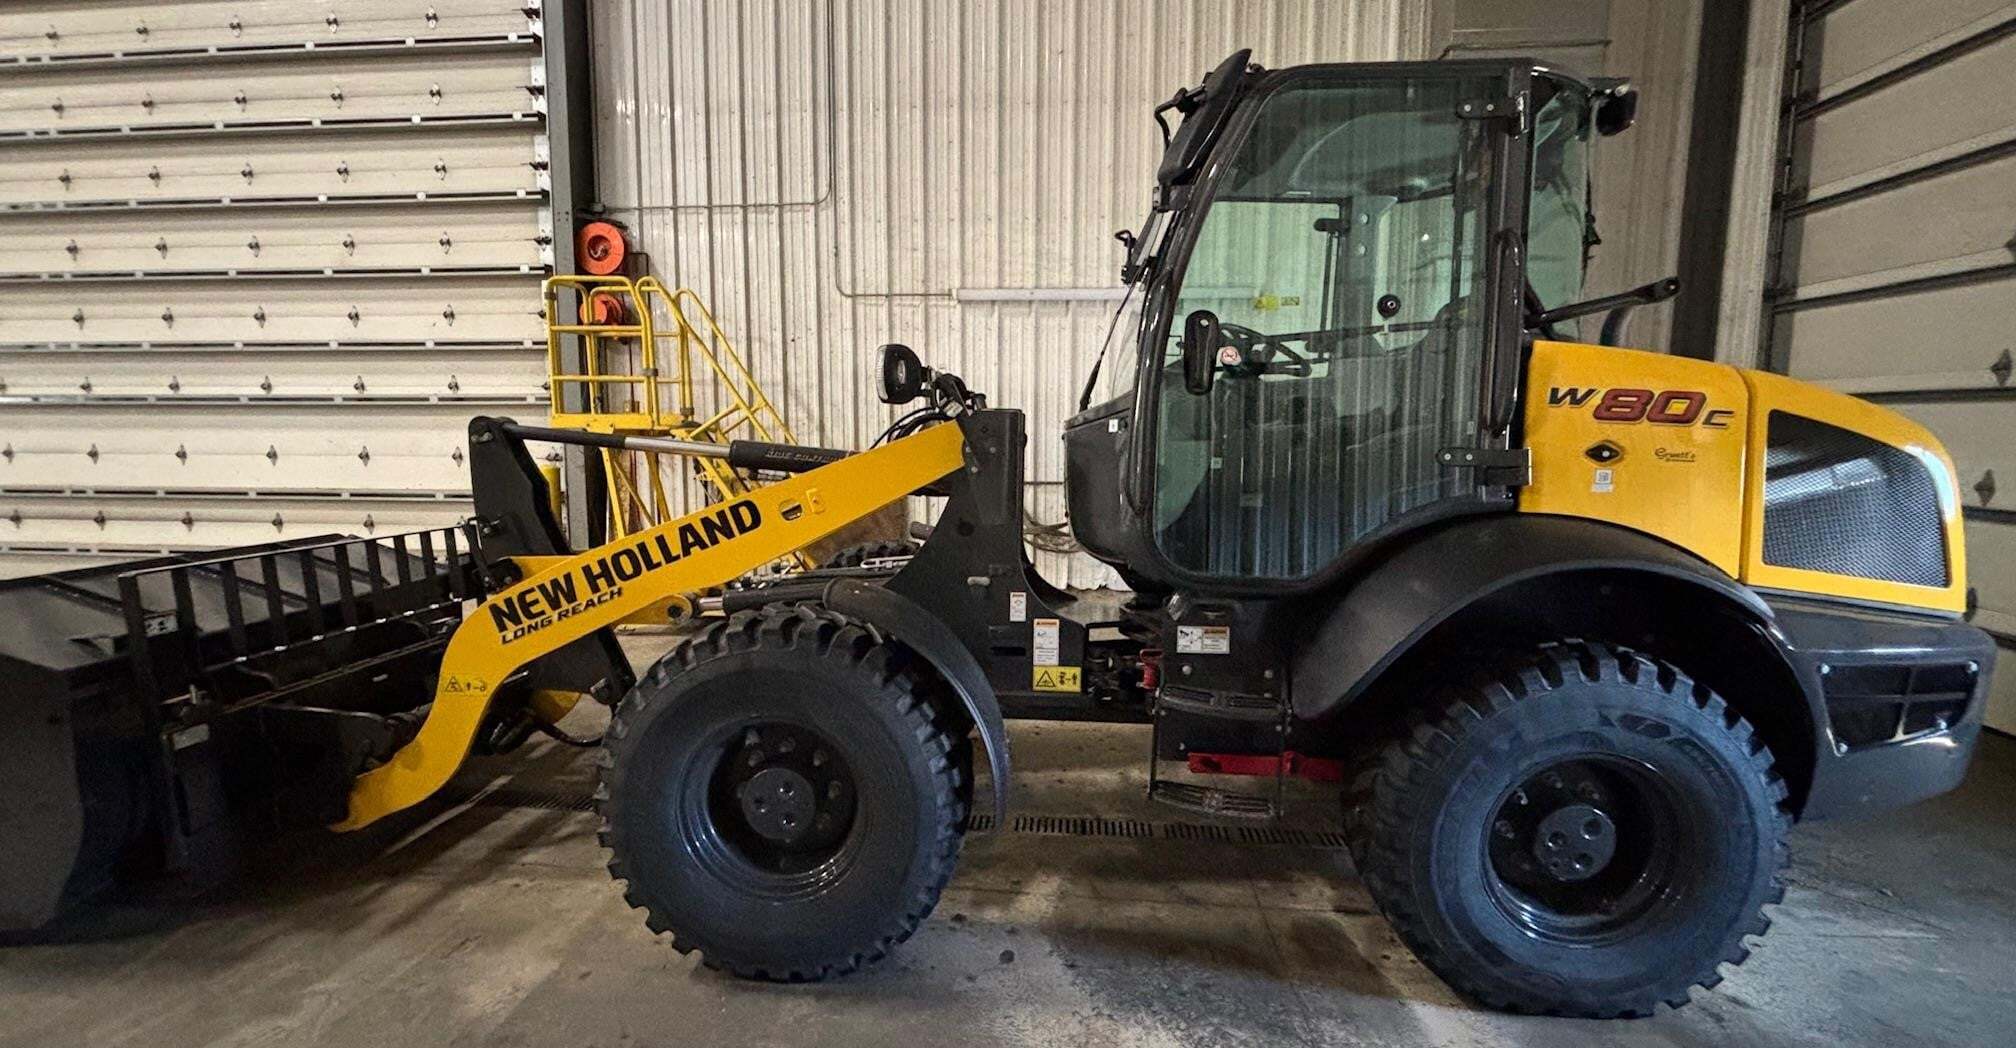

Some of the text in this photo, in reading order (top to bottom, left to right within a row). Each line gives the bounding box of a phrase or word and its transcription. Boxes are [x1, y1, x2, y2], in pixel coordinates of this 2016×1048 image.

[488, 499, 762, 633] NEW HOLLAND
[501, 586, 623, 645] LONG REACH
